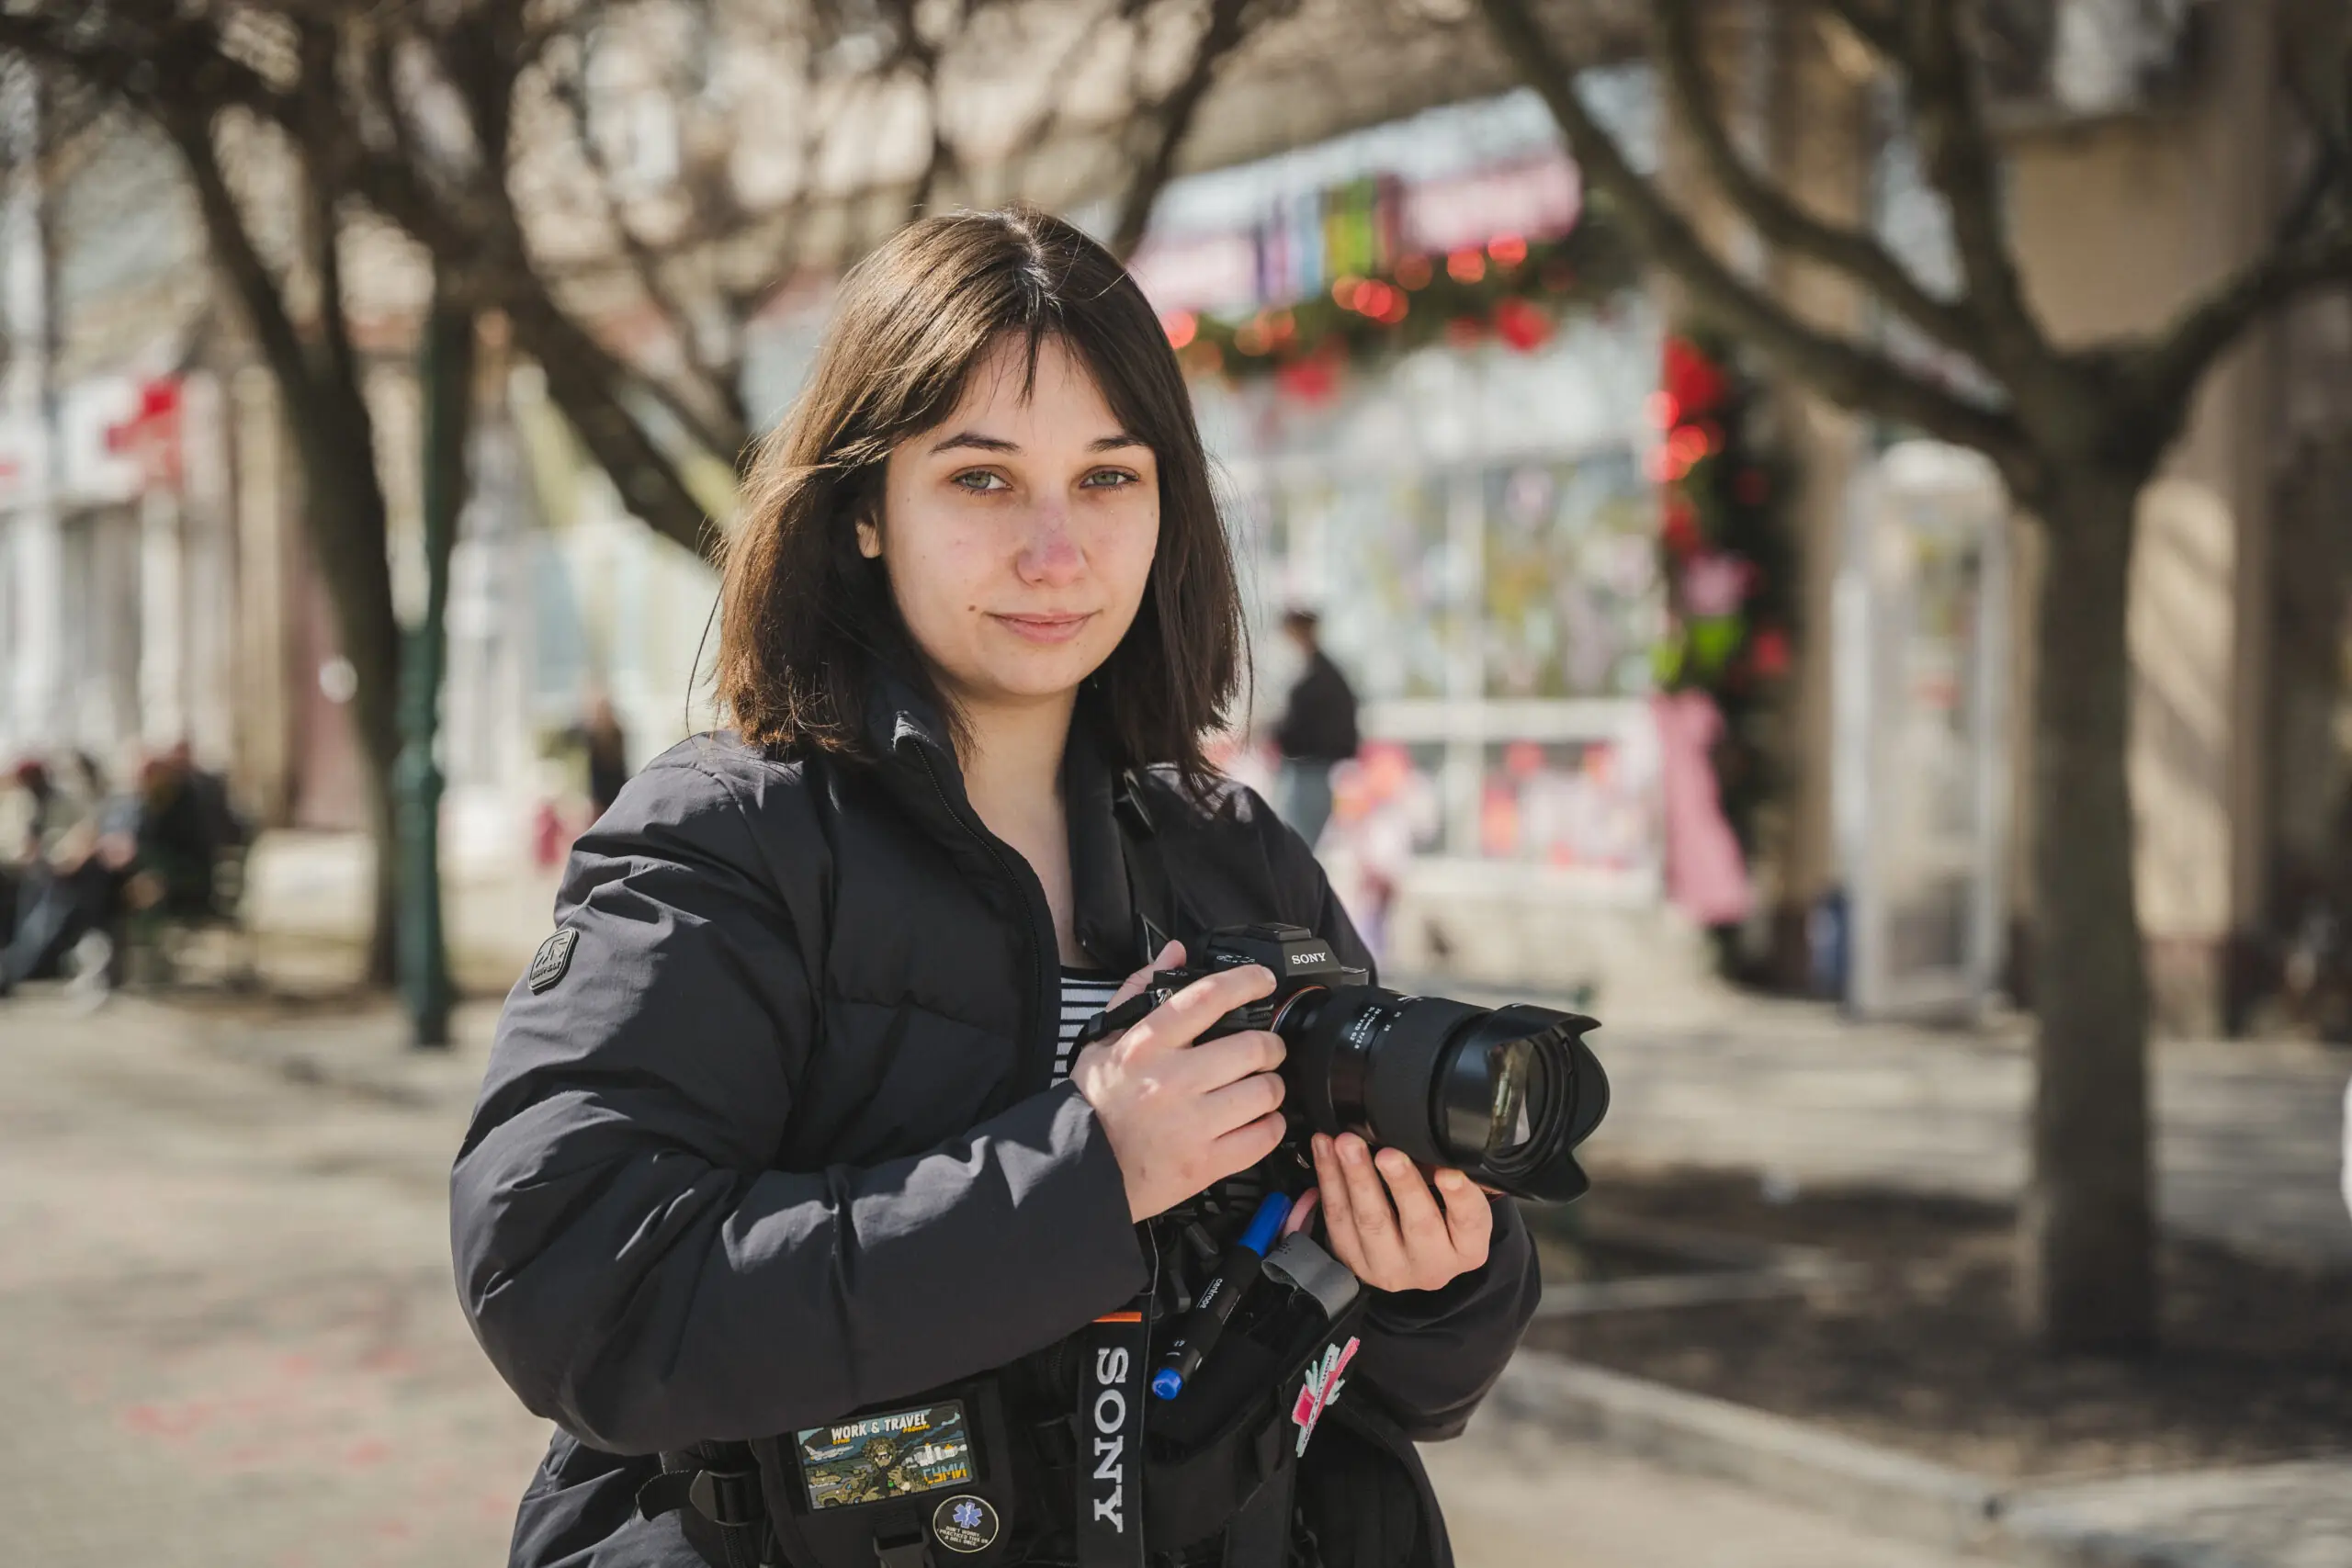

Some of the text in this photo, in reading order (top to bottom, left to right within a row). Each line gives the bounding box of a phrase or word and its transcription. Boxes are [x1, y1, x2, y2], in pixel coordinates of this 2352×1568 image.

[1291, 952, 1326, 964] SONY
[831, 1423, 867, 1441] WORK
[871, 1422, 880, 1433] &
[884, 1413, 927, 1432] TRAVEL
[1092, 1347, 1129, 1533] SONY
